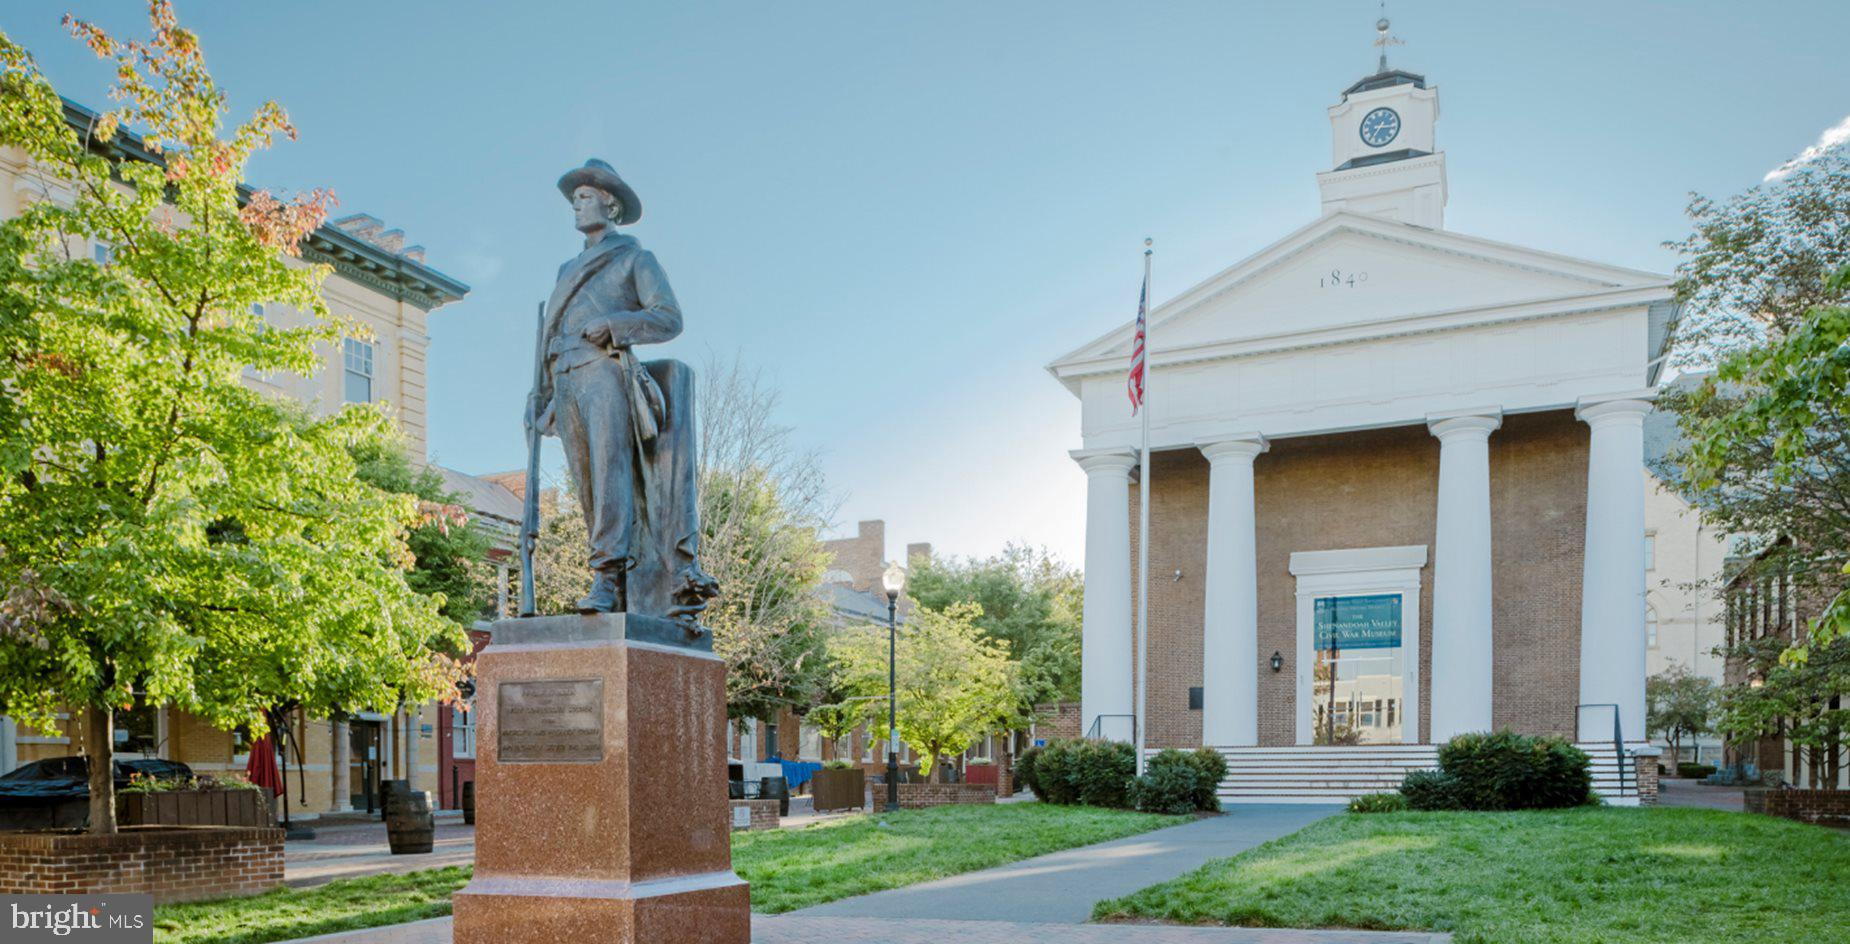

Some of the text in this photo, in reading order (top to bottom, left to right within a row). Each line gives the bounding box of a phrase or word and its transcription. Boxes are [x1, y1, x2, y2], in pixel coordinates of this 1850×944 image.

[1320, 268, 1369, 290] 1840
[1341, 630, 1359, 639] WAR
[1361, 629, 1397, 638] MUSEUM
